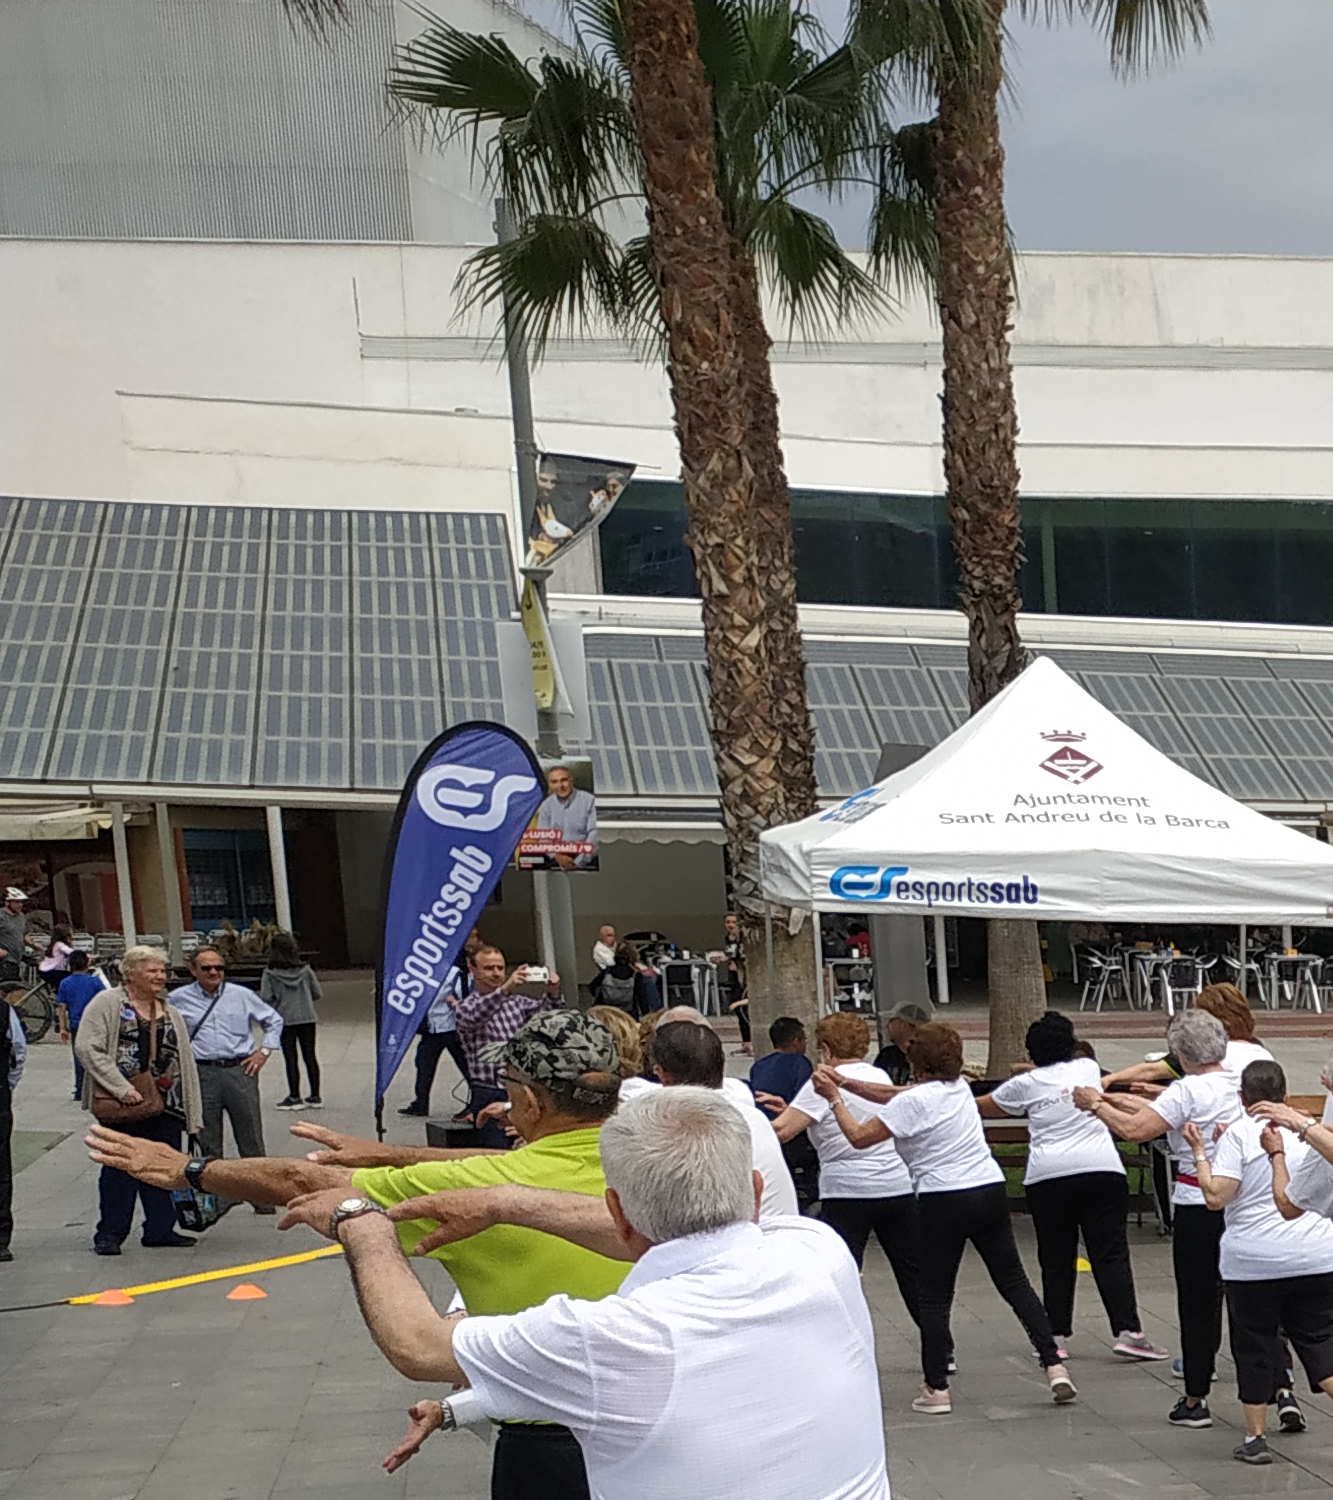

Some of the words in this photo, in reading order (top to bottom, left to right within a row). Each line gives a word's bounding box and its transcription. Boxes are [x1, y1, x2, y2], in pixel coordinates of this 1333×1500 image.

[1013, 793, 1151, 809] Ajuntament
[938, 812, 996, 824] Sant
[1004, 811, 1091, 824] Andreu
[1098, 810, 1128, 824] de
[1136, 812, 1157, 826] la
[1165, 814, 1231, 830] Barca
[520, 842, 578, 853] COMPROMÍS
[896, 875, 1039, 908] esportssab
[387, 844, 493, 1015] esportssab
